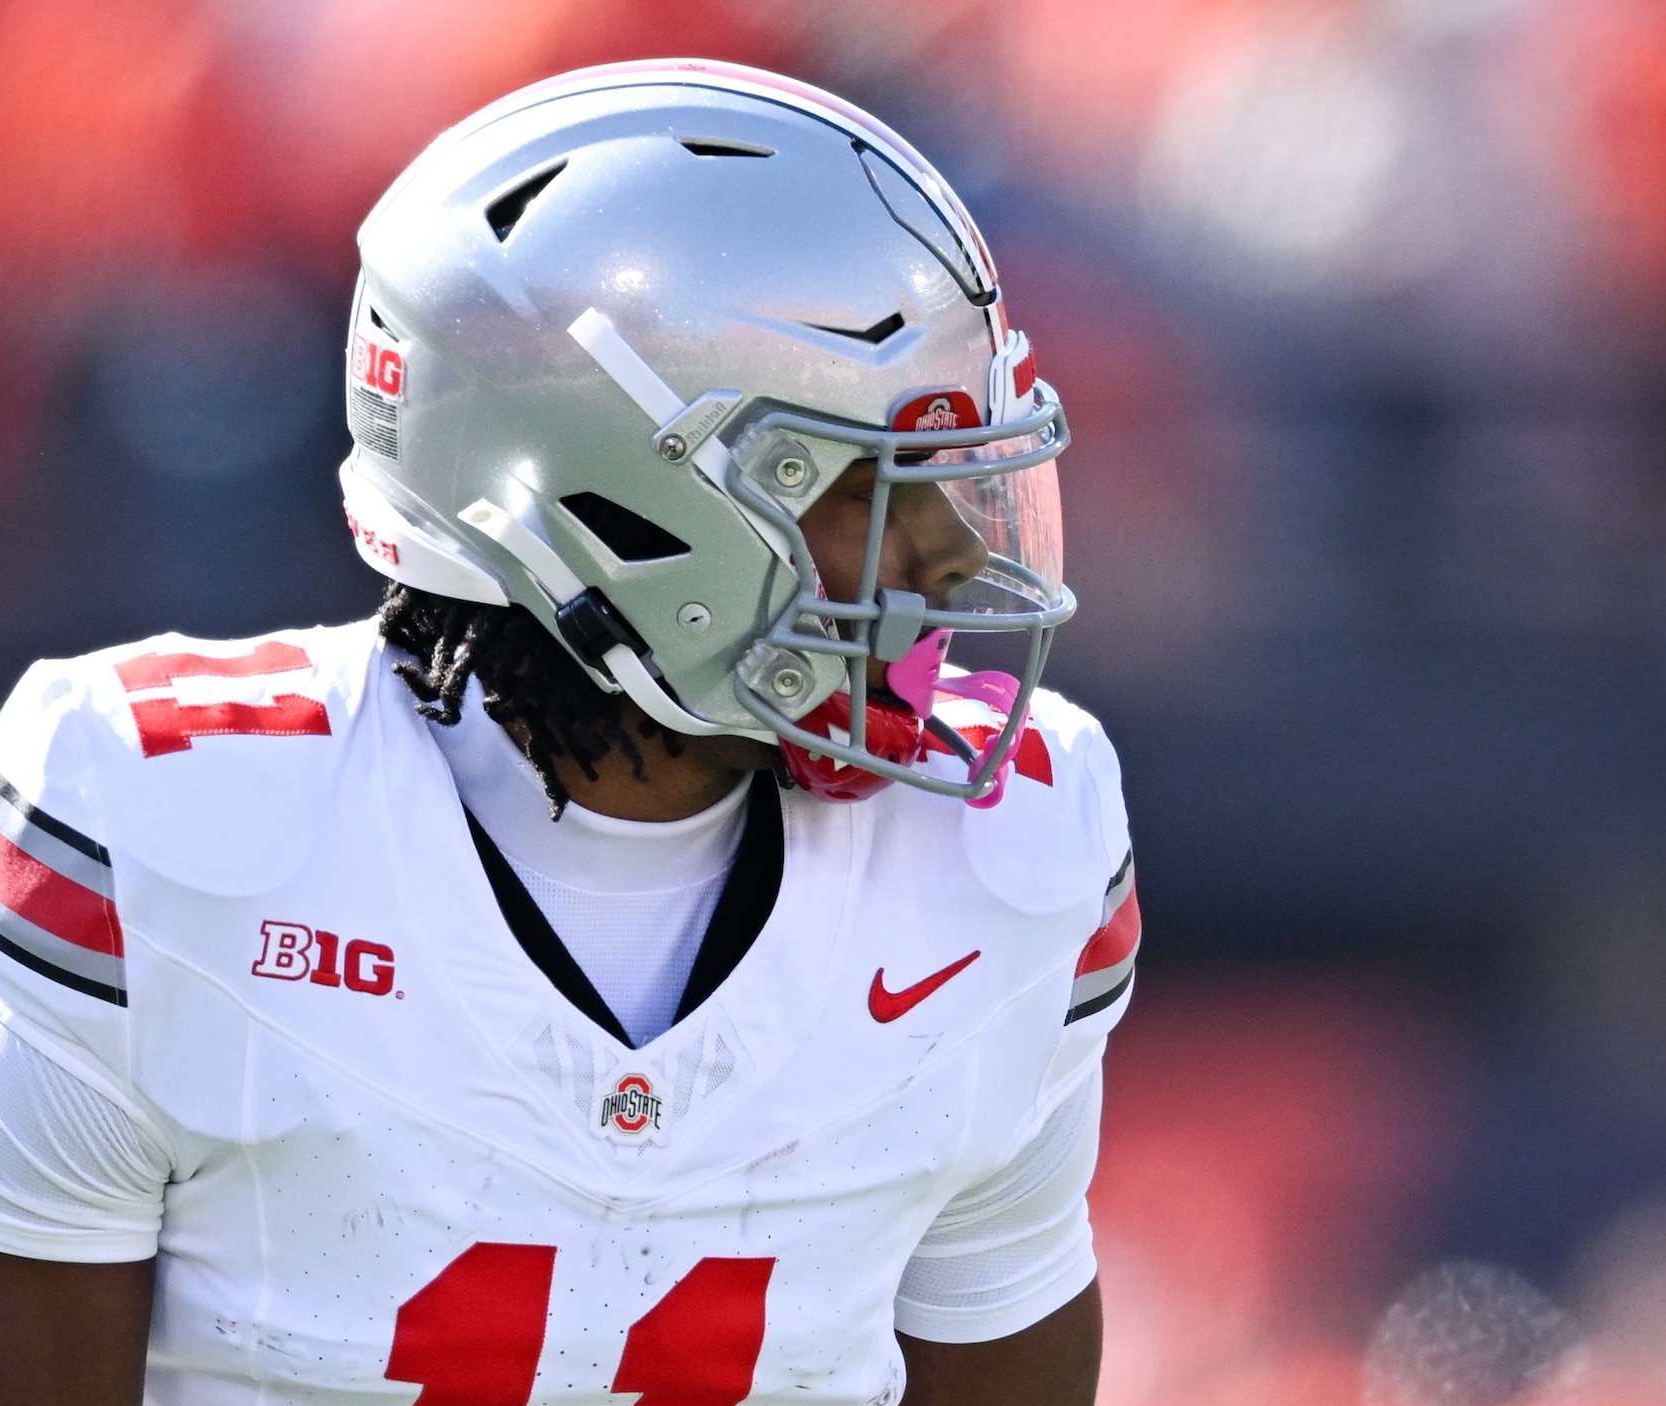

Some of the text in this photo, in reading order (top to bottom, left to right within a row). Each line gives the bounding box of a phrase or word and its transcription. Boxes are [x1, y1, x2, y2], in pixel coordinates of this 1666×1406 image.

[113, 641, 332, 758] 11
[601, 1089, 662, 1130] OHIO STATE
